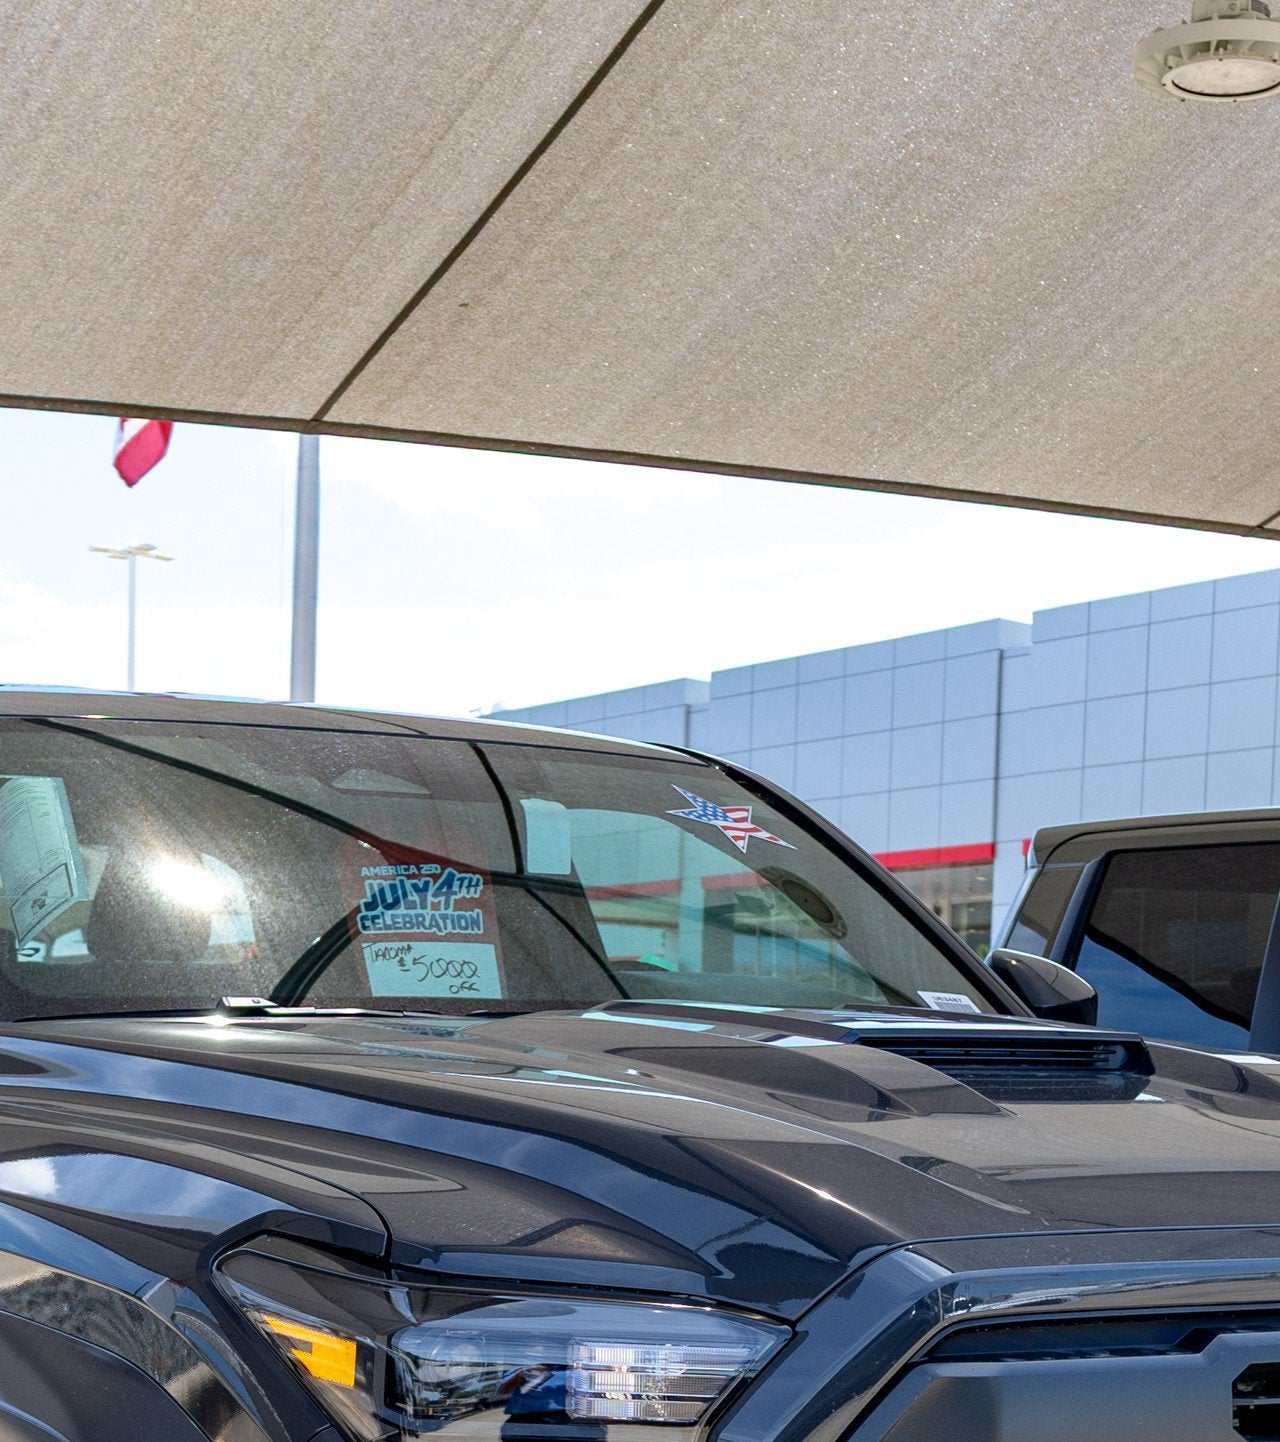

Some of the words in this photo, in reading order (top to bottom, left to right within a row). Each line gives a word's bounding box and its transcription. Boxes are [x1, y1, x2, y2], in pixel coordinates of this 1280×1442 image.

[361, 865, 419, 876] AMERICA
[419, 863, 442, 875] 250
[362, 877, 432, 912] JULY
[431, 869, 482, 912] 4TH
[358, 910, 483, 934] CELEBRATION
